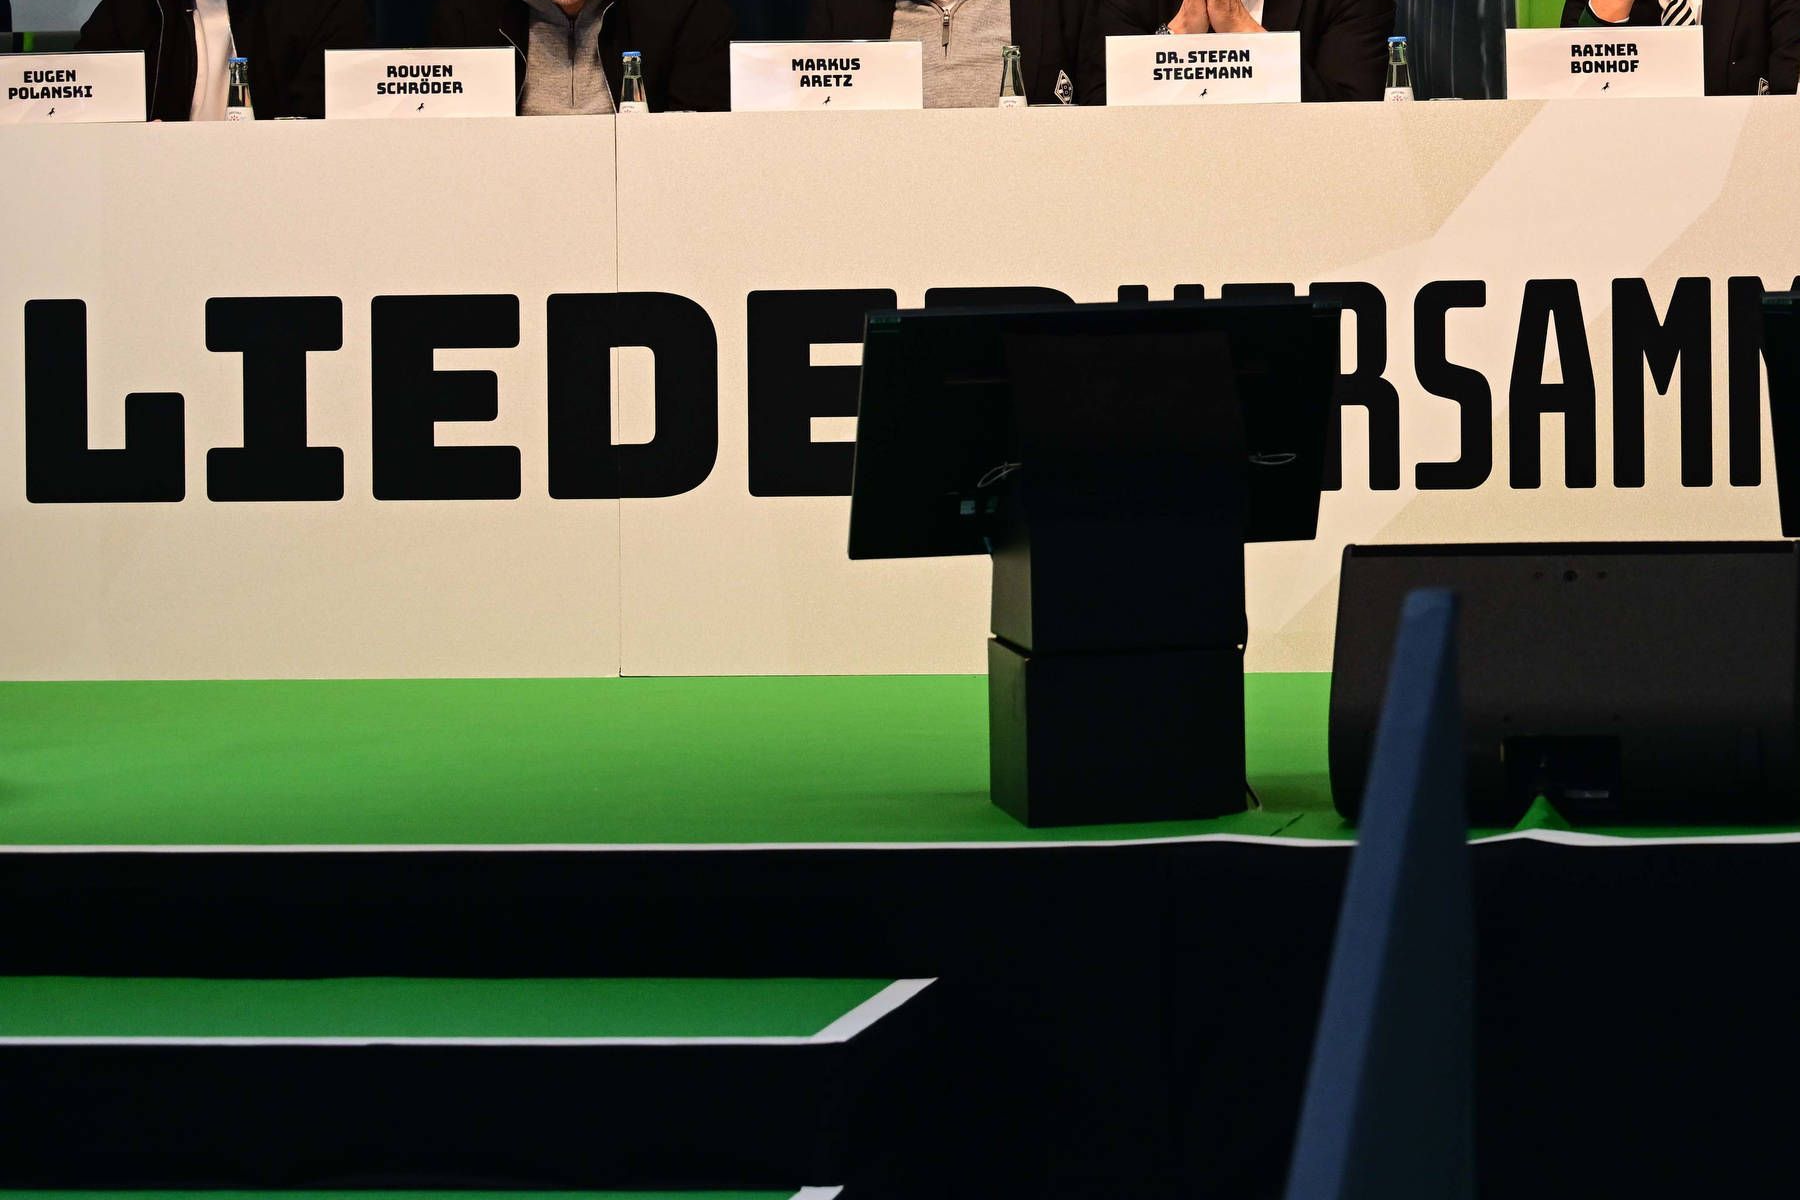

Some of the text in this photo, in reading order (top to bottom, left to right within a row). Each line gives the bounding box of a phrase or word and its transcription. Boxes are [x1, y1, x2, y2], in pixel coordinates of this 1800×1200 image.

[1155, 49, 1251, 65] DR. STEFAN
[1570, 43, 1639, 58] RAINER
[386, 64, 453, 79] ROUVEN
[791, 57, 861, 72] MARKUS
[1570, 59, 1640, 74] BONHOF
[23, 69, 77, 84] EUGEN
[1153, 65, 1254, 81] STEGEMANN
[376, 77, 464, 95] SCHRÖDER
[799, 74, 853, 88] ARETZ
[8, 85, 93, 100] POLANSKI
